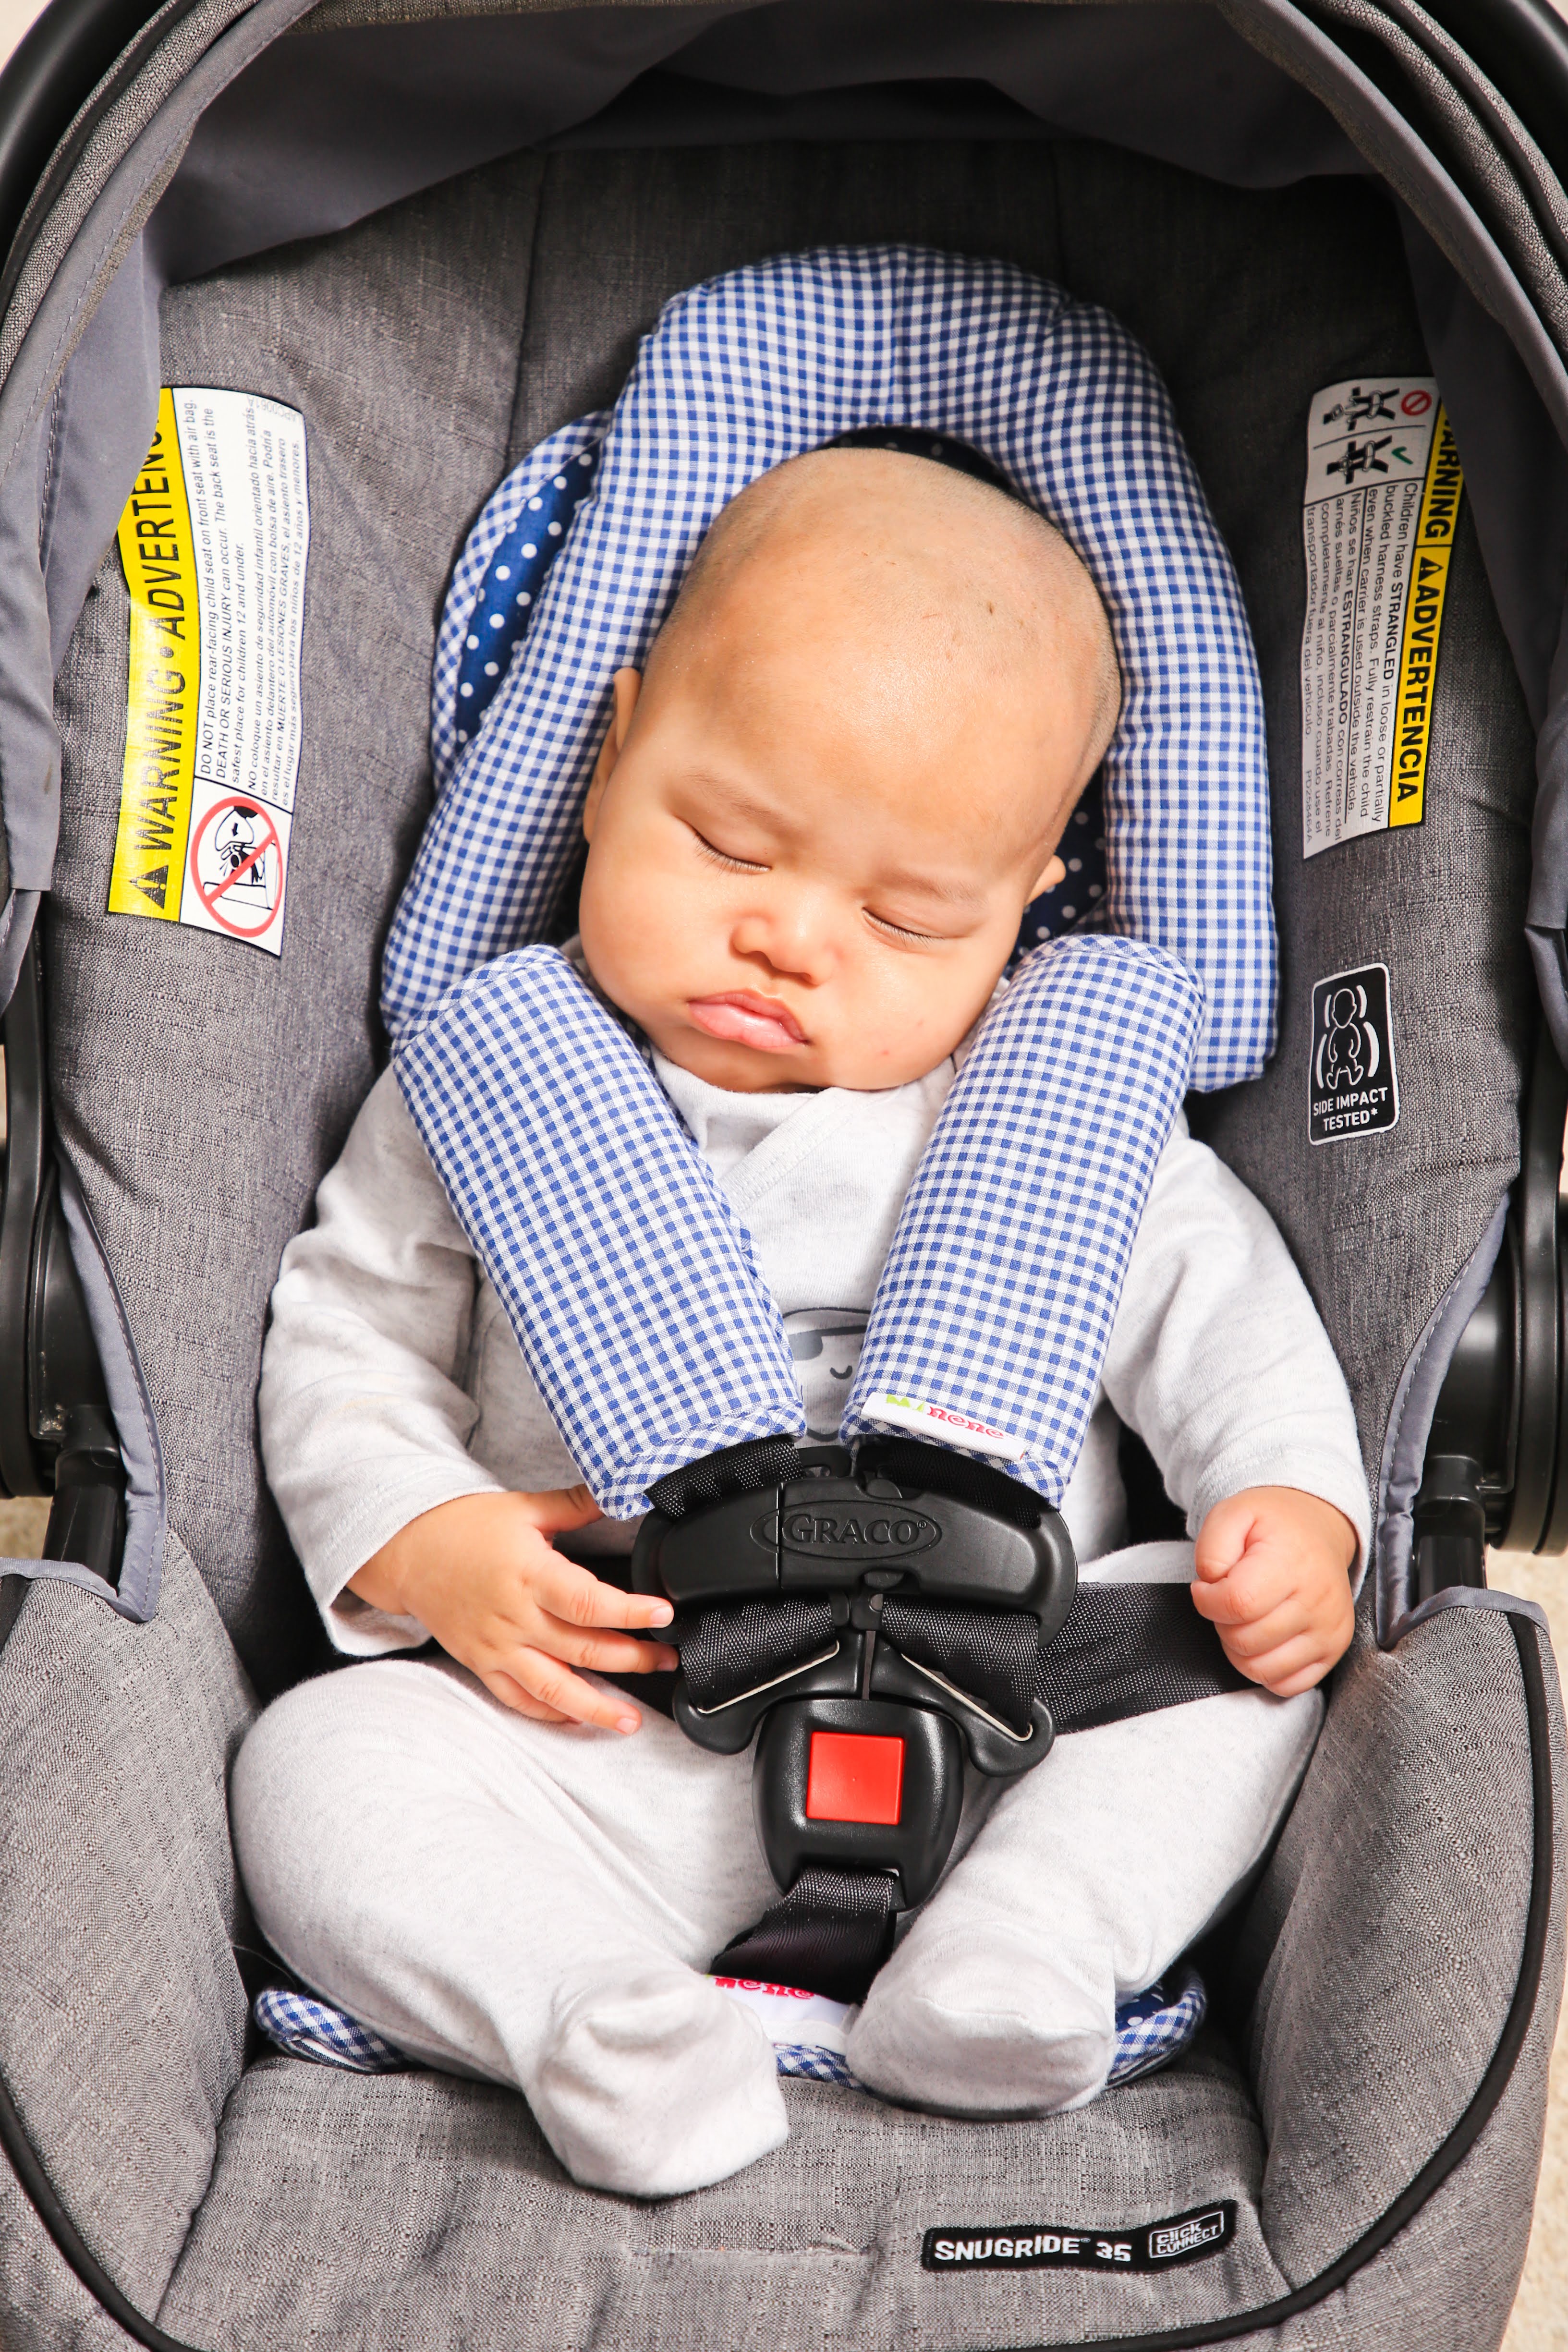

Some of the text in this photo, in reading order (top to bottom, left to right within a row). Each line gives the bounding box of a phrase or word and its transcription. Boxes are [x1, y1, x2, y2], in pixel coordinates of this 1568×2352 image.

[202, 409, 214, 426] the
[184, 426, 197, 440] air
[204, 430, 216, 439] is
[187, 445, 201, 467] with
[206, 443, 219, 467] seat
[246, 439, 258, 469] hacia
[278, 438, 287, 479] trasero
[191, 472, 205, 495] seat
[209, 472, 223, 498] back
[196, 499, 209, 526] front
[214, 502, 226, 521] The
[248, 473, 263, 526] orientado
[267, 499, 276, 513] de
[280, 483, 290, 524] asiento
[1349, 493, 1362, 534] Niños
[200, 530, 211, 545] on
[268, 517, 277, 548] bolsa
[282, 527, 290, 538] el
[1349, 538, 1357, 556] se
[201, 548, 213, 573] seat
[254, 528, 264, 570] infantil
[268, 552, 277, 573] con
[293, 542, 302, 555] 12
[1307, 506, 1318, 604] transportador
[1320, 502, 1331, 613] completamente
[221, 569, 231, 590] can
[292, 561, 300, 576] de
[1346, 559, 1357, 586] han
[204, 577, 216, 607] child
[235, 583, 245, 608] and
[255, 572, 265, 632] seguridad
[221, 593, 232, 642] INJURY
[236, 611, 246, 624] 12
[1305, 608, 1317, 643] fuera
[1318, 618, 1325, 630] al
[1398, 419, 1461, 803] ARNING ADVERTENCIA
[130, 417, 185, 850] WARNING ADVERTEN
[277, 599, 286, 663] LESIONES
[289, 619, 297, 637] los
[206, 612, 219, 680] rear-facing
[236, 630, 246, 681] children
[255, 636, 263, 650] de
[1339, 590, 1353, 724] ESTRANGULADO
[1348, 488, 1378, 814] even when carrier is used outside the vehicle.
[1360, 484, 1399, 817] buckled harness straps. Fully restrain the child
[1372, 482, 1418, 822] Children have STRANGLED in loose or partially
[278, 666, 285, 676] O
[1304, 649, 1313, 670] del
[1325, 497, 1345, 837] arnés sueltas o parcialmente trabadas. Refrene
[221, 645, 232, 705] SERIOUS
[255, 654, 264, 697] asiento
[266, 661, 274, 715] delantero
[205, 684, 216, 719] place
[236, 684, 245, 703] for
[277, 679, 286, 732] MUERTE
[288, 671, 297, 712] seguro
[1316, 674, 1325, 726] incluso
[219, 709, 230, 728] OR
[254, 701, 262, 715] un
[202, 721, 213, 750] NOT
[233, 707, 244, 741] place
[216, 733, 228, 778] DEATH
[251, 720, 261, 767] coloque
[263, 720, 272, 764] asiento
[276, 737, 283, 751] en
[201, 754, 211, 774] DO
[231, 744, 241, 783] safest
[262, 766, 268, 777] el
[283, 744, 294, 775] lugar
[248, 771, 256, 790] NO
[261, 782, 267, 796] en
[271, 754, 281, 800] resultar
[283, 777, 290, 788] el
[1336, 760, 1344, 814] correas
[282, 792, 289, 806] es
[1315, 820, 1323, 833] el
[1313, 1087, 1388, 1116] SIDE IMPACT
[1096, 2242, 1132, 2262] 35
